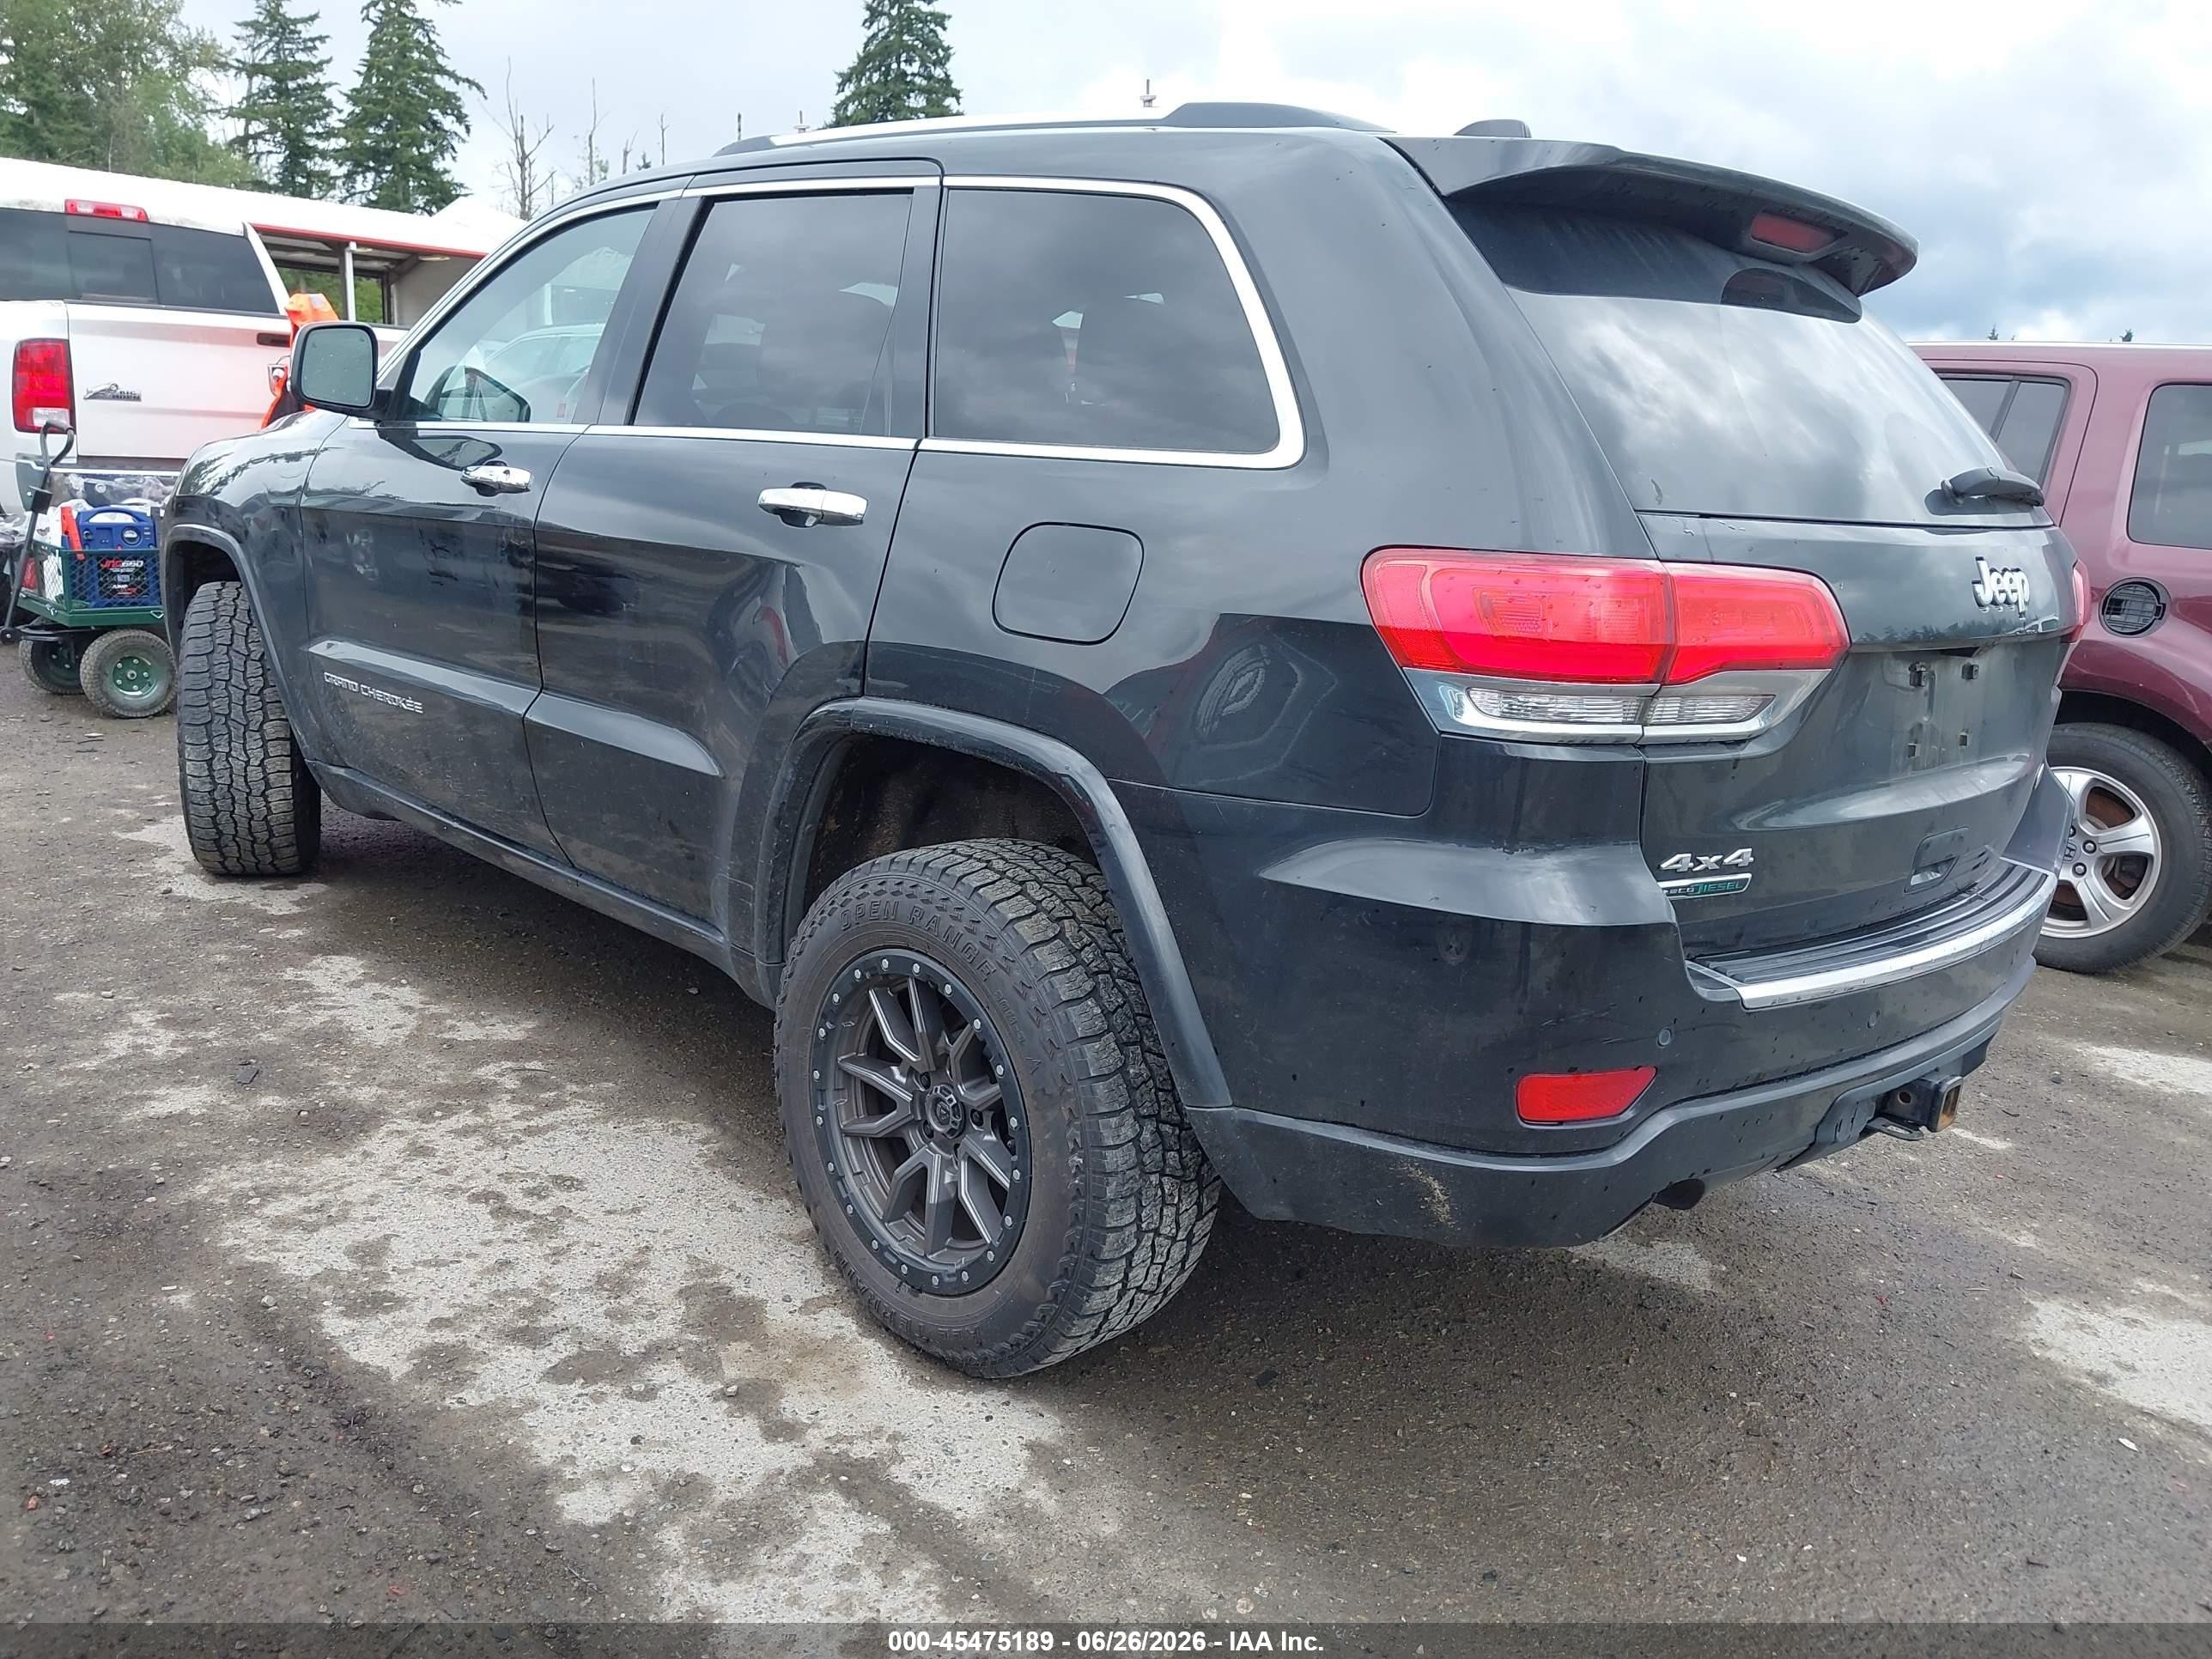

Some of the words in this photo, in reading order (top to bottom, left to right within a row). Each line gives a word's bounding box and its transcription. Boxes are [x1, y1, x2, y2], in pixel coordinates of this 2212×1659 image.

[1972, 557, 2030, 618] Jeep
[324, 672, 359, 692] GRAND
[360, 684, 424, 714] CHEROKEE
[1658, 848, 1754, 872] 4x4
[841, 901, 899, 931] OPEN
[908, 905, 997, 981] RANGE
